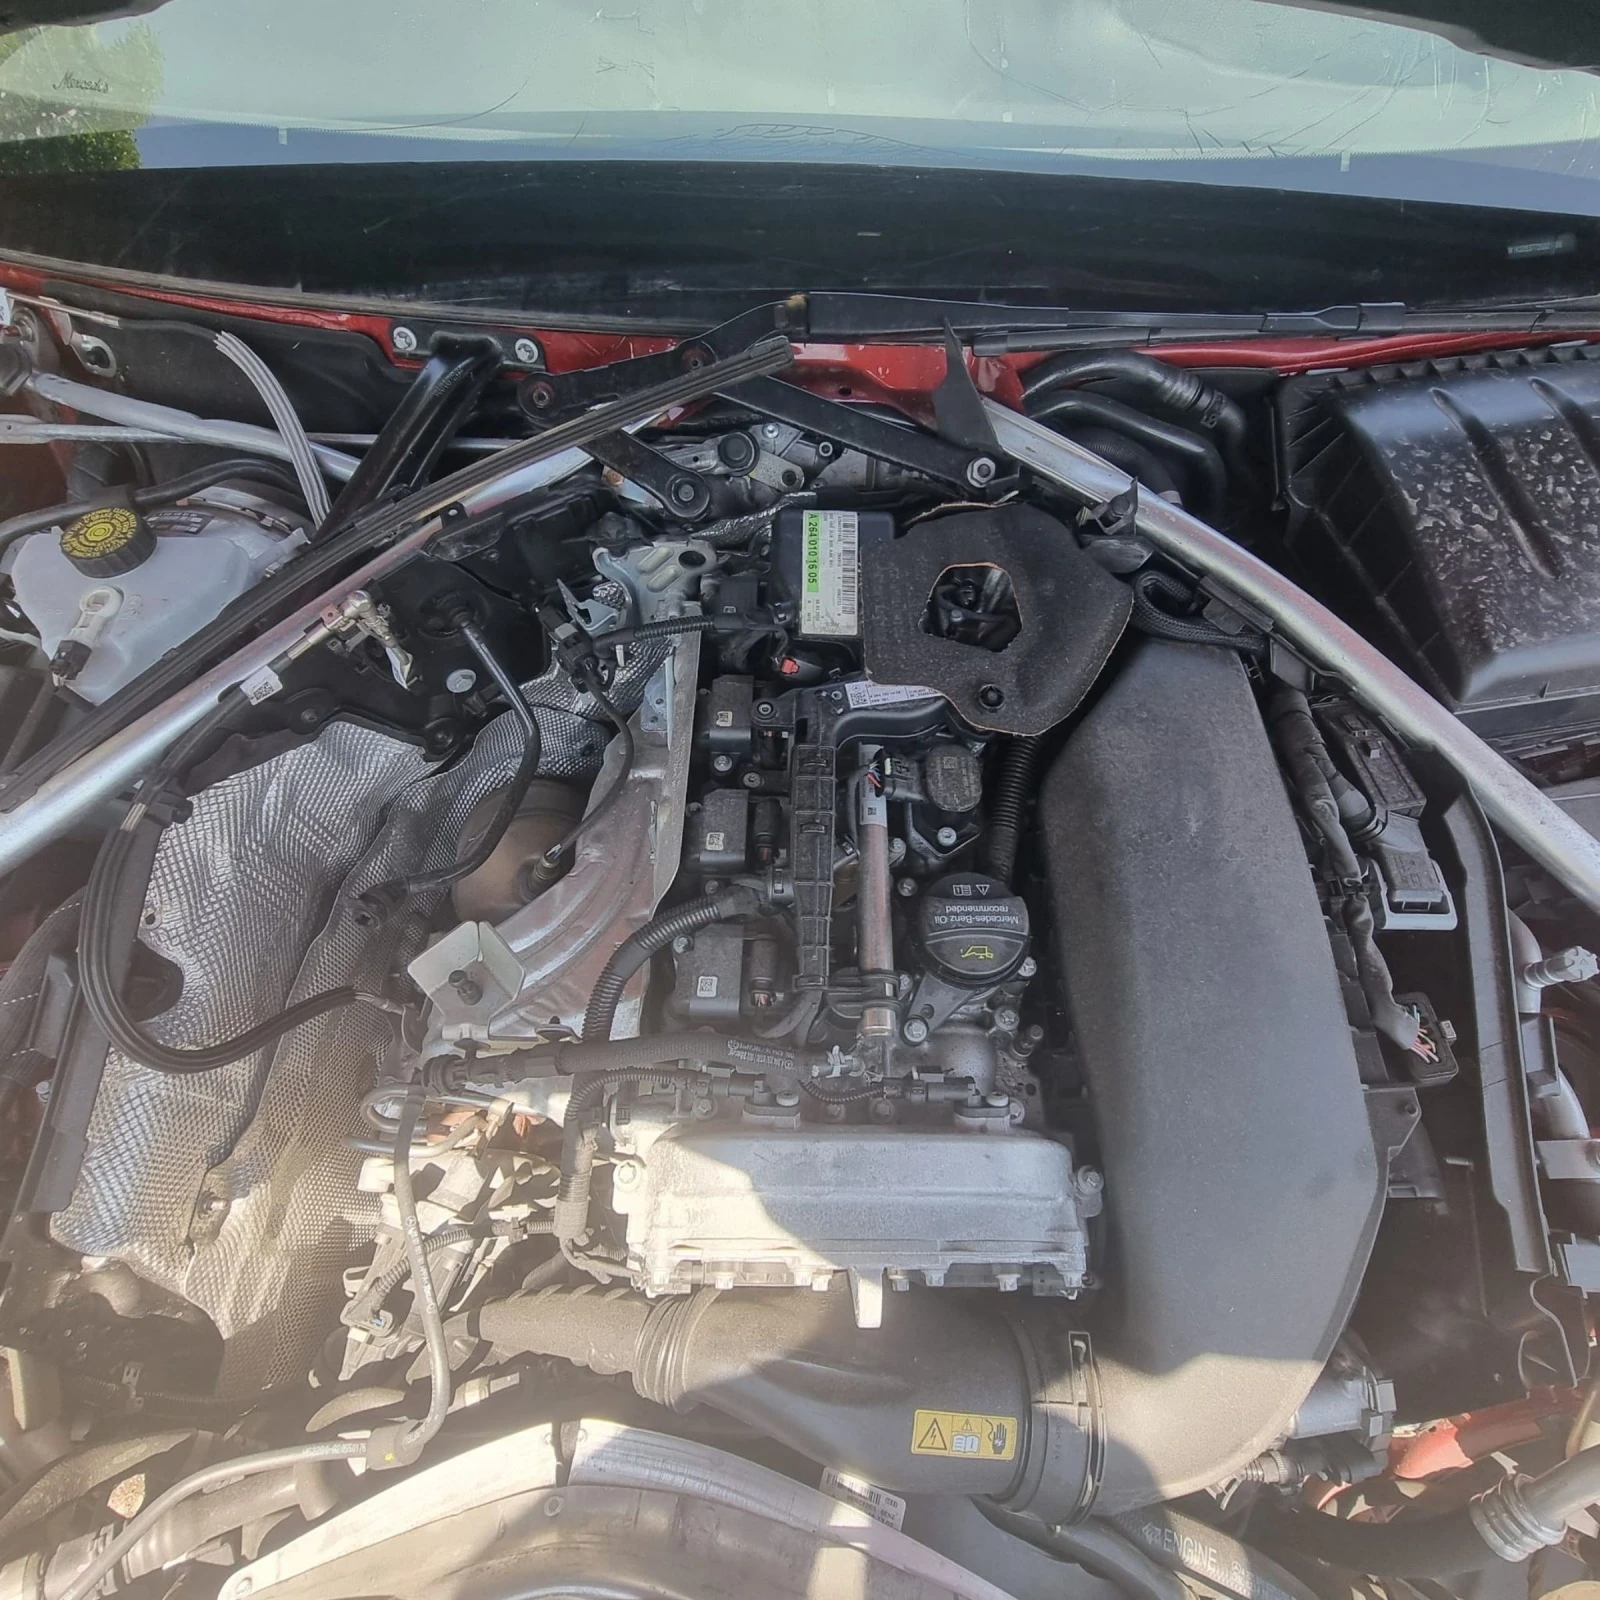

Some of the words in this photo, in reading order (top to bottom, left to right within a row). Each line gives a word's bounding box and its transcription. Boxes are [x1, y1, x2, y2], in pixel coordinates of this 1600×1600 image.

[808, 522, 818, 537] 264
[808, 540, 818, 556] 010
[808, 560, 818, 570] 16
[808, 572, 818, 584] 05
[945, 905, 1009, 913] recommended
[934, 915, 947, 924] Oil
[949, 915, 1019, 925] Mercedes-Benz
[1163, 1527, 1218, 1572] ENGINE
